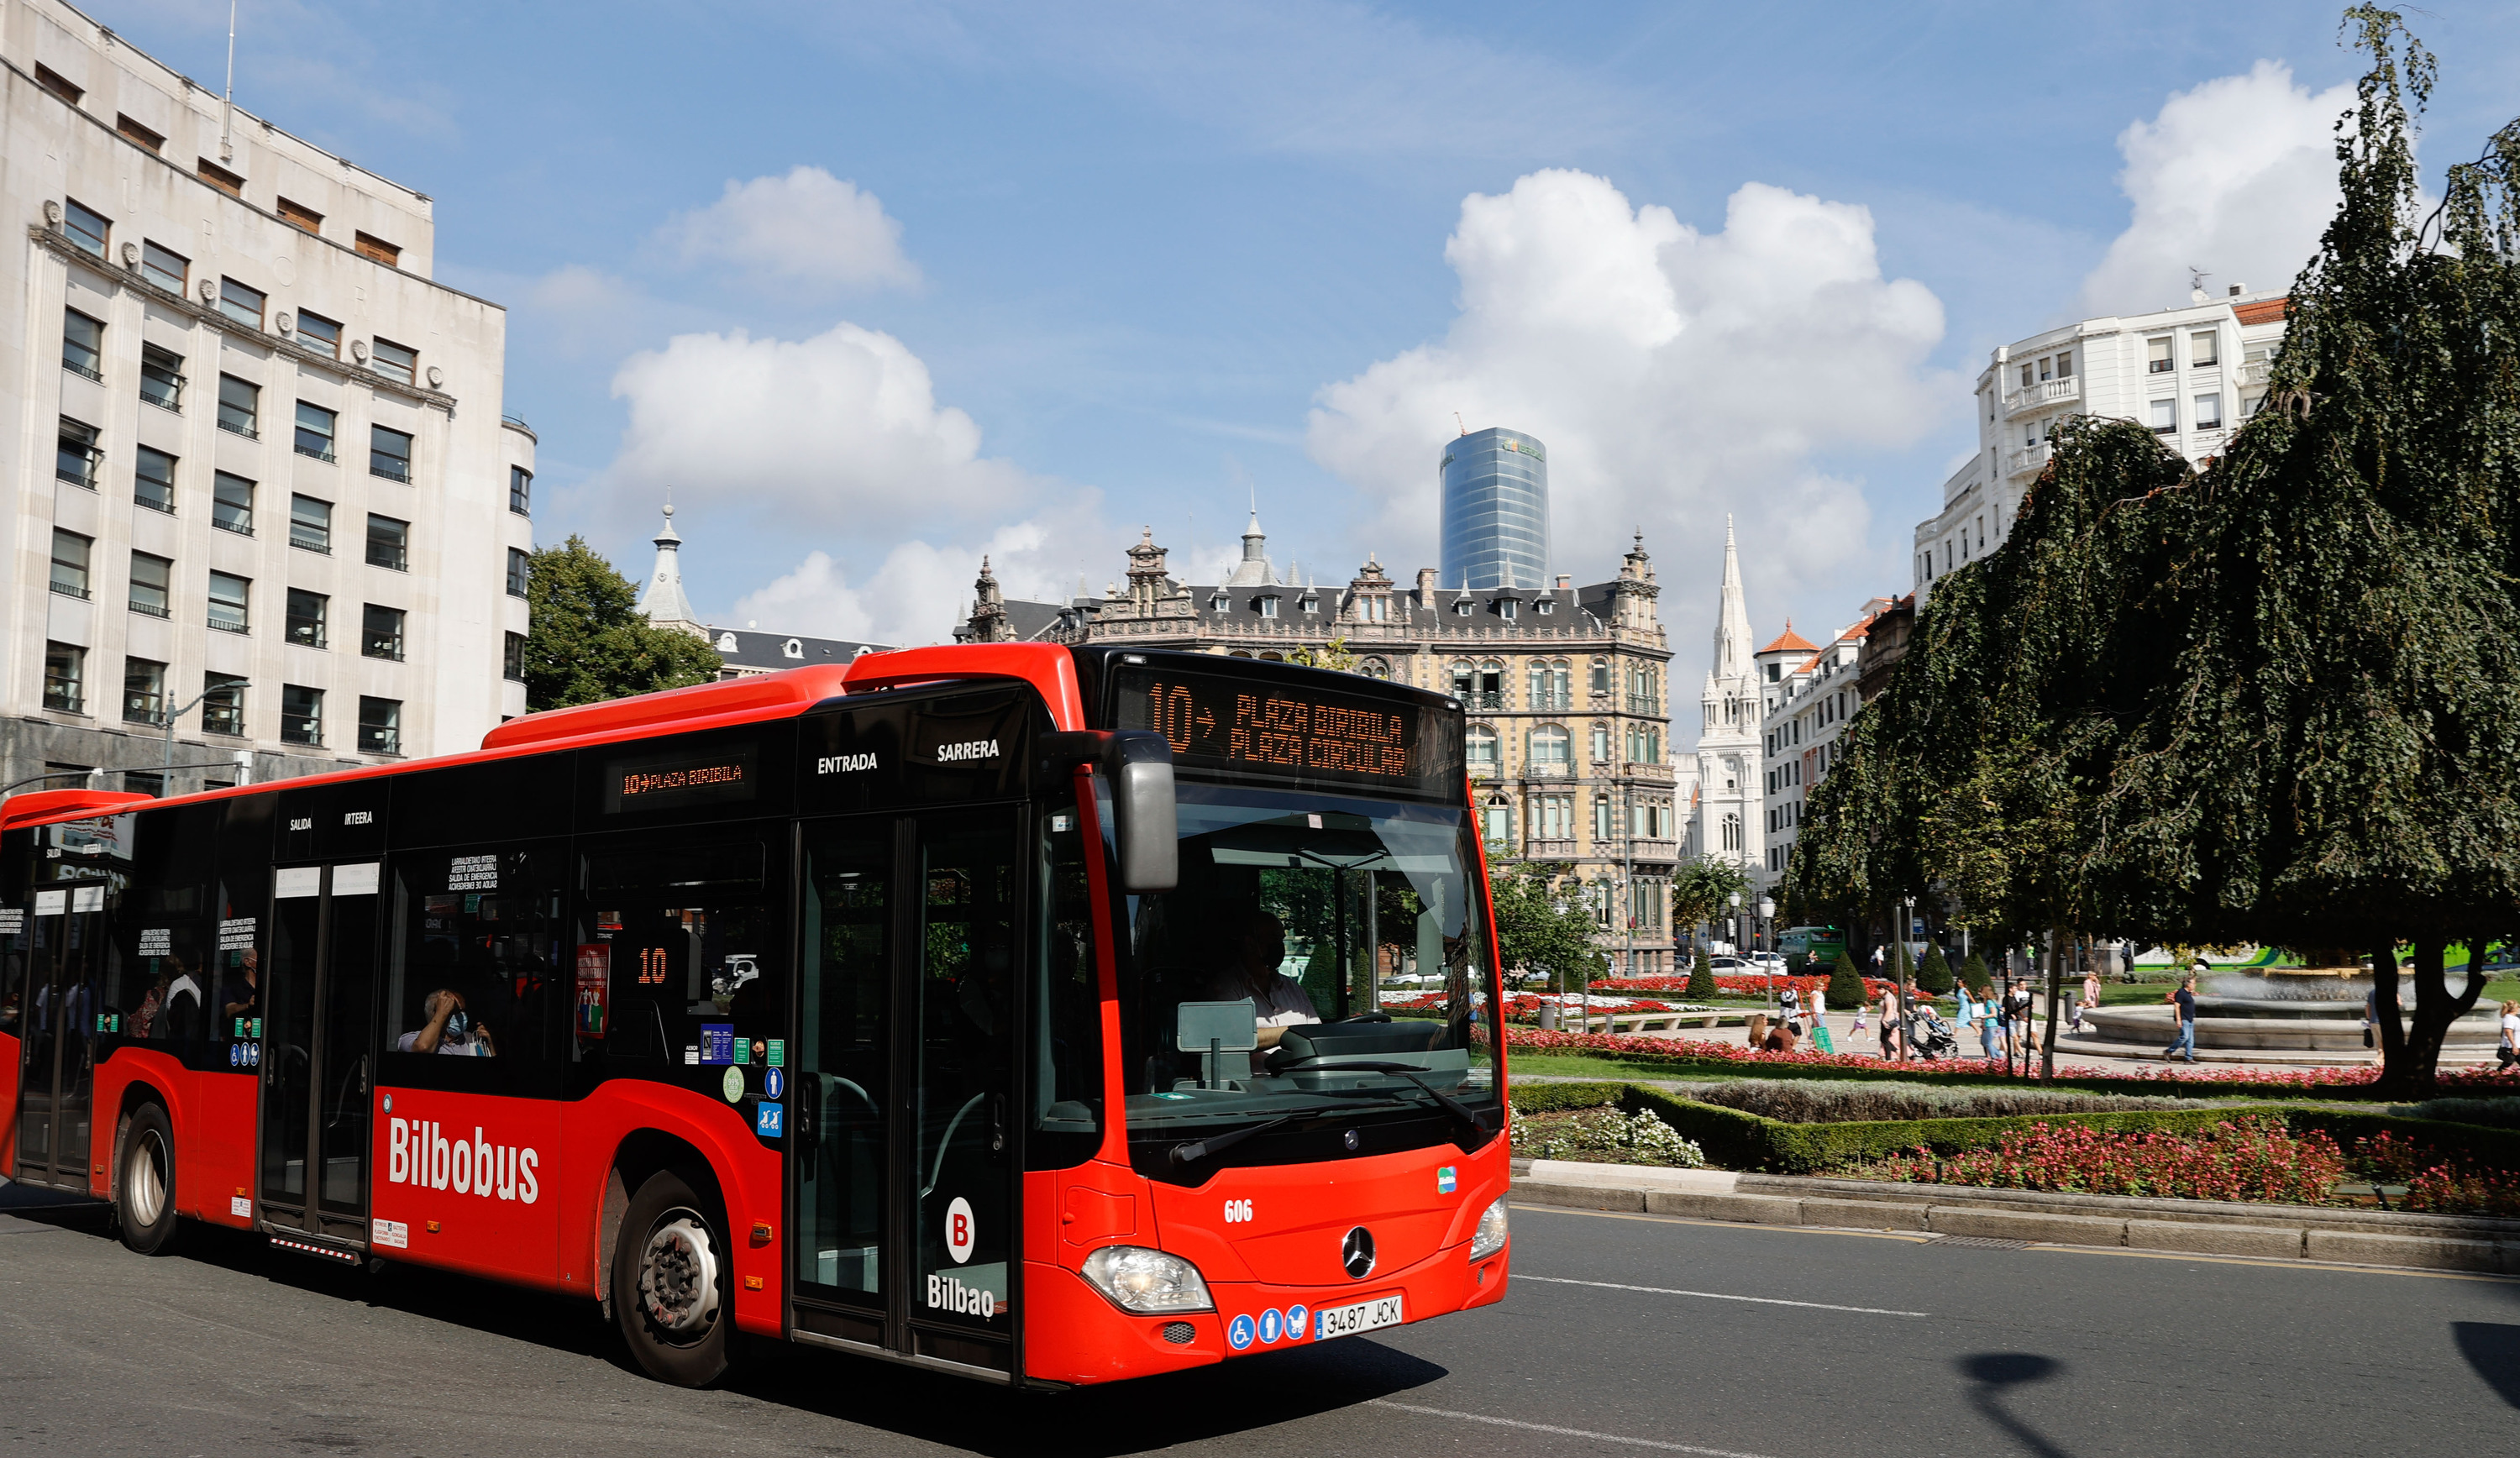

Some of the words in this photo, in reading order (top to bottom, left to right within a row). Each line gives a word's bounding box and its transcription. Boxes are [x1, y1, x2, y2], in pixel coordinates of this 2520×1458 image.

[1149, 683, 1192, 753] 10
[1236, 694, 1308, 733] PLAZA
[1314, 705, 1402, 744] BIRIBILA
[818, 753, 877, 774] ENTRADA
[937, 739, 1000, 762] SARRERA
[1230, 728, 1302, 765] PLAZA
[1309, 737, 1405, 776] CIRCULAR
[623, 774, 639, 795] 10
[650, 772, 685, 789] PLAZA
[689, 765, 742, 785] BIRIBILA
[290, 818, 312, 831] SALIDA
[344, 811, 372, 825] IRTEERA
[449, 873, 463, 883] SALIDA
[470, 872, 497, 881] EMERGENCIA
[638, 947, 666, 983] 10
[389, 1117, 538, 1204] Bilbobus
[1224, 1198, 1253, 1223] 606
[953, 1213, 969, 1247] B
[927, 1274, 995, 1318] Bilbao
[1327, 1306, 1366, 1334] 3487
[1372, 1298, 1399, 1324] JCK
